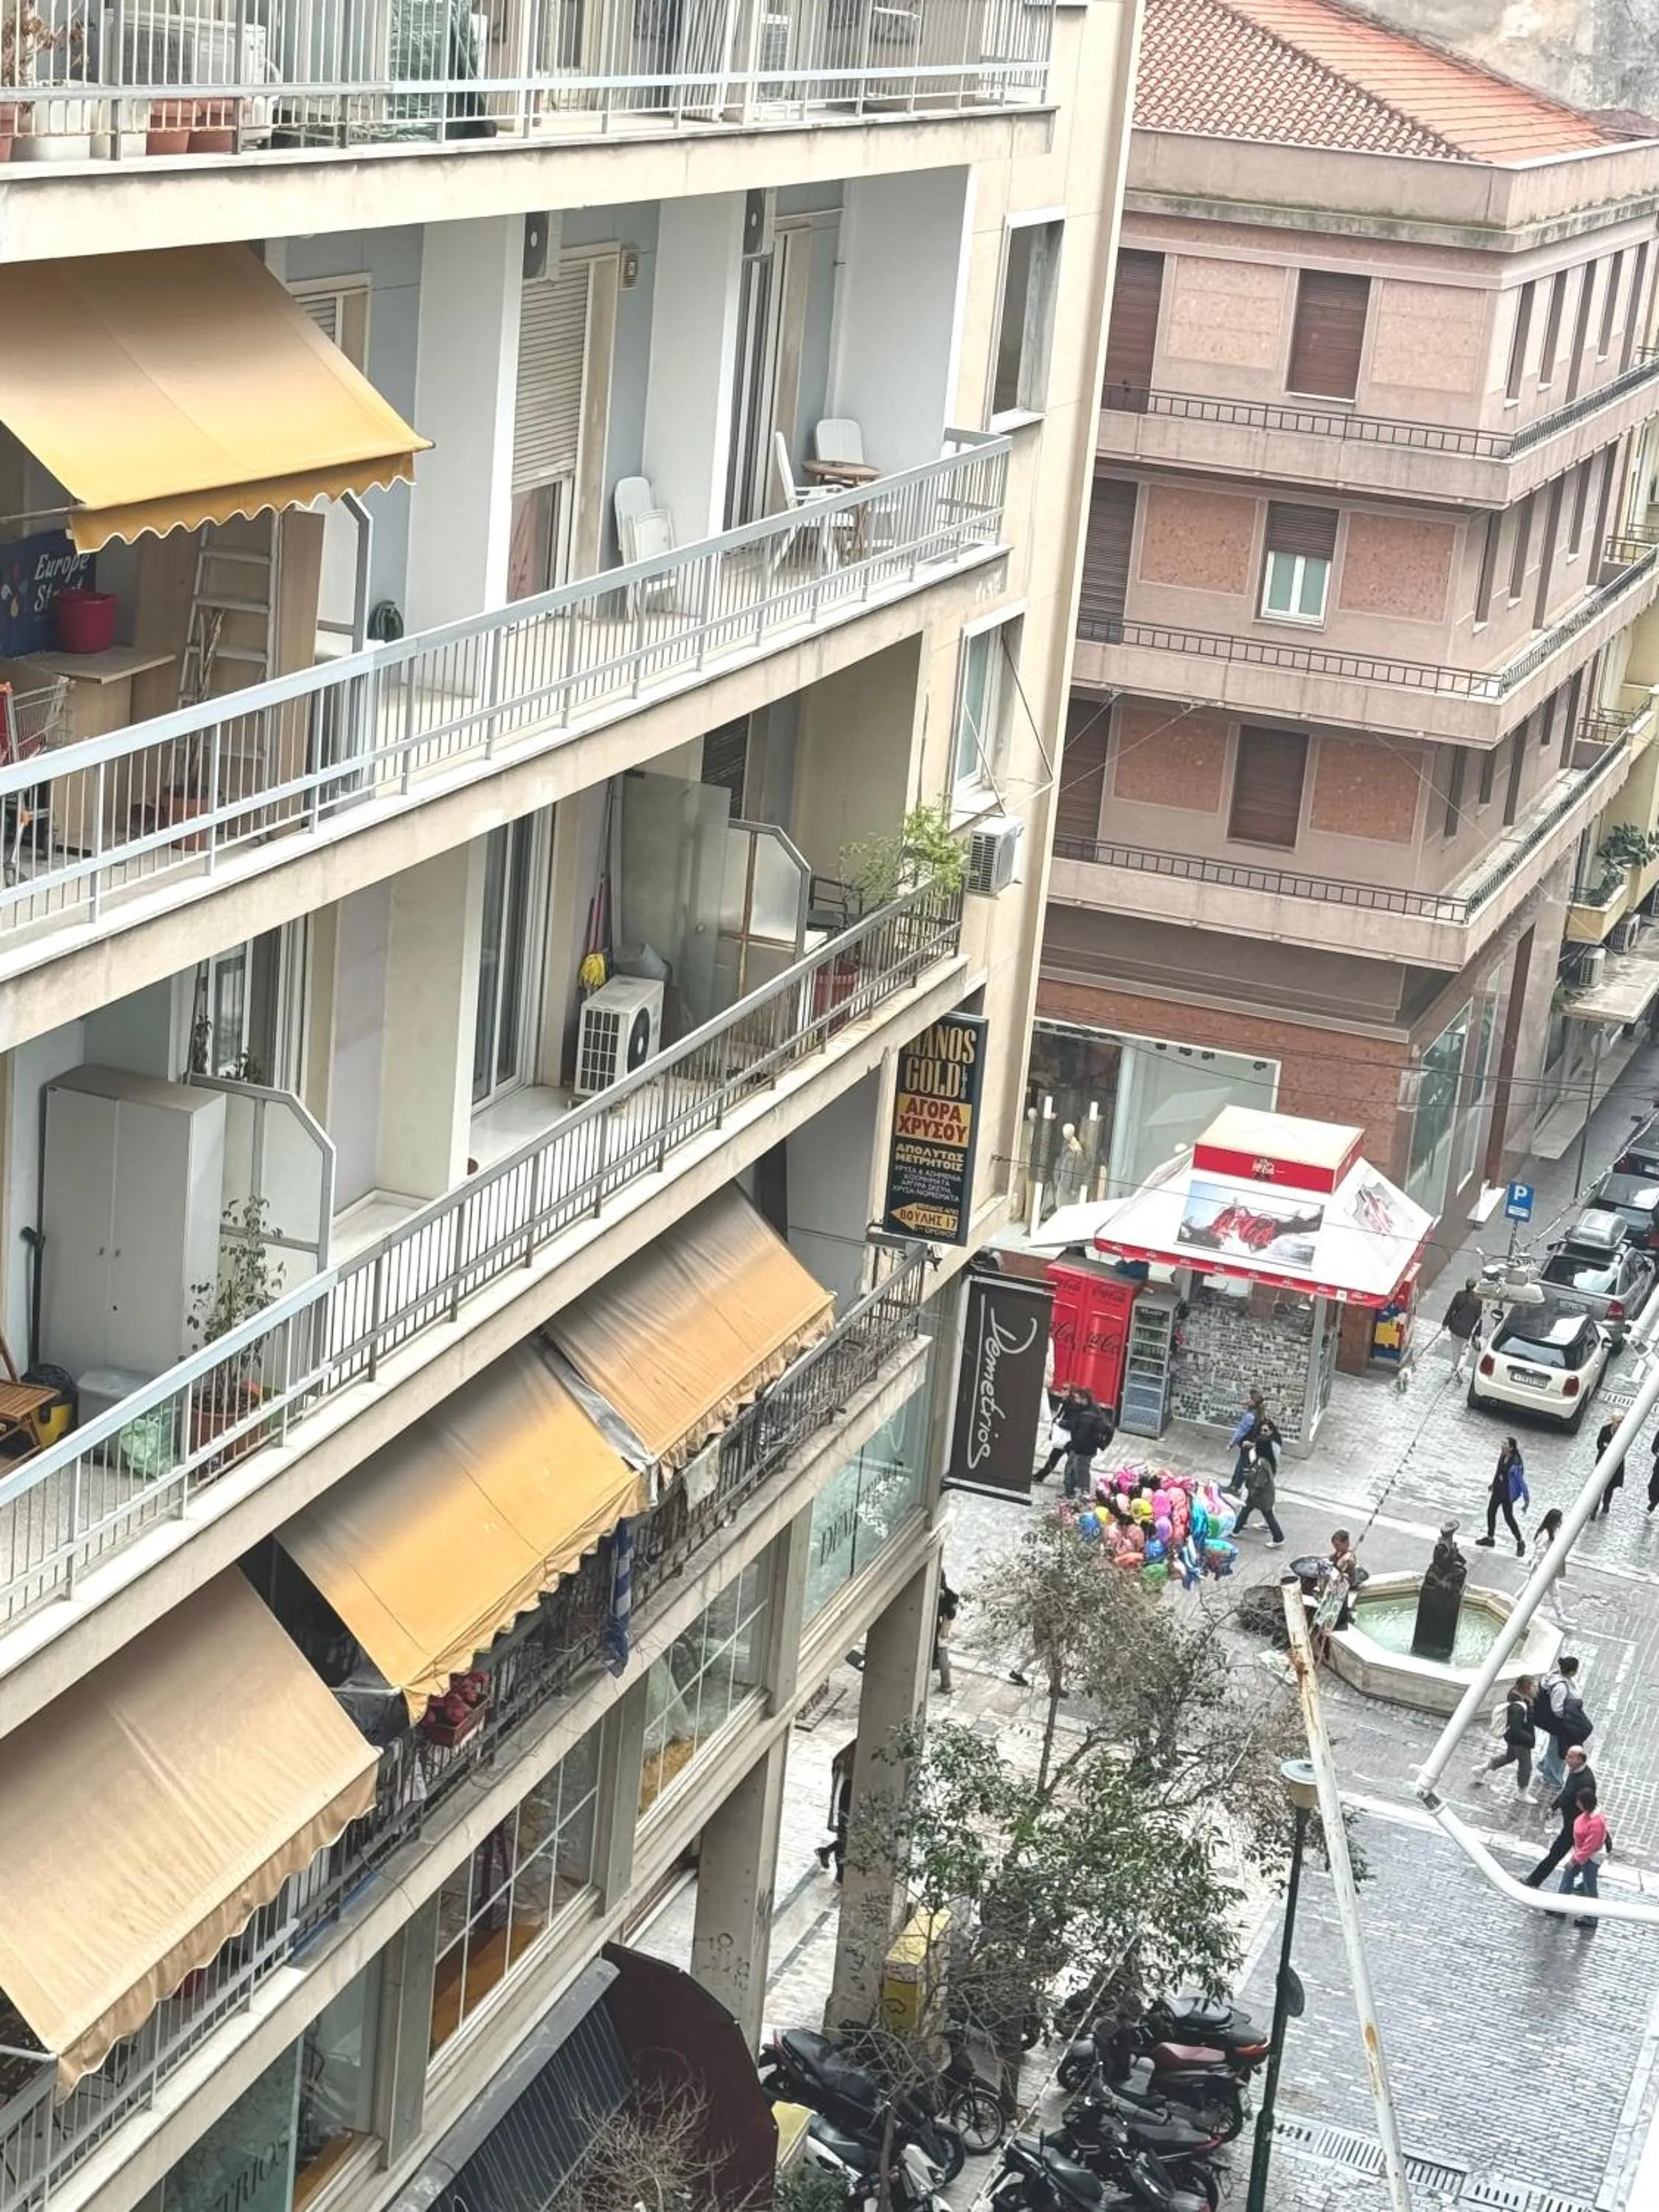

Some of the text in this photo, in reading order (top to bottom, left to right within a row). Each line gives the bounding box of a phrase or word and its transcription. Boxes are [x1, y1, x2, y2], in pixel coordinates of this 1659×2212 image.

[35, 554, 91, 584] Europe
[905, 1057, 961, 1098] GOLD
[905, 1097, 962, 1123] ΑΓΟΡΑ
[898, 1114, 968, 1144] ΧΡΥΣΟΥ
[1513, 1185, 1528, 1200] P
[967, 1294, 1038, 1470] Demetrios
